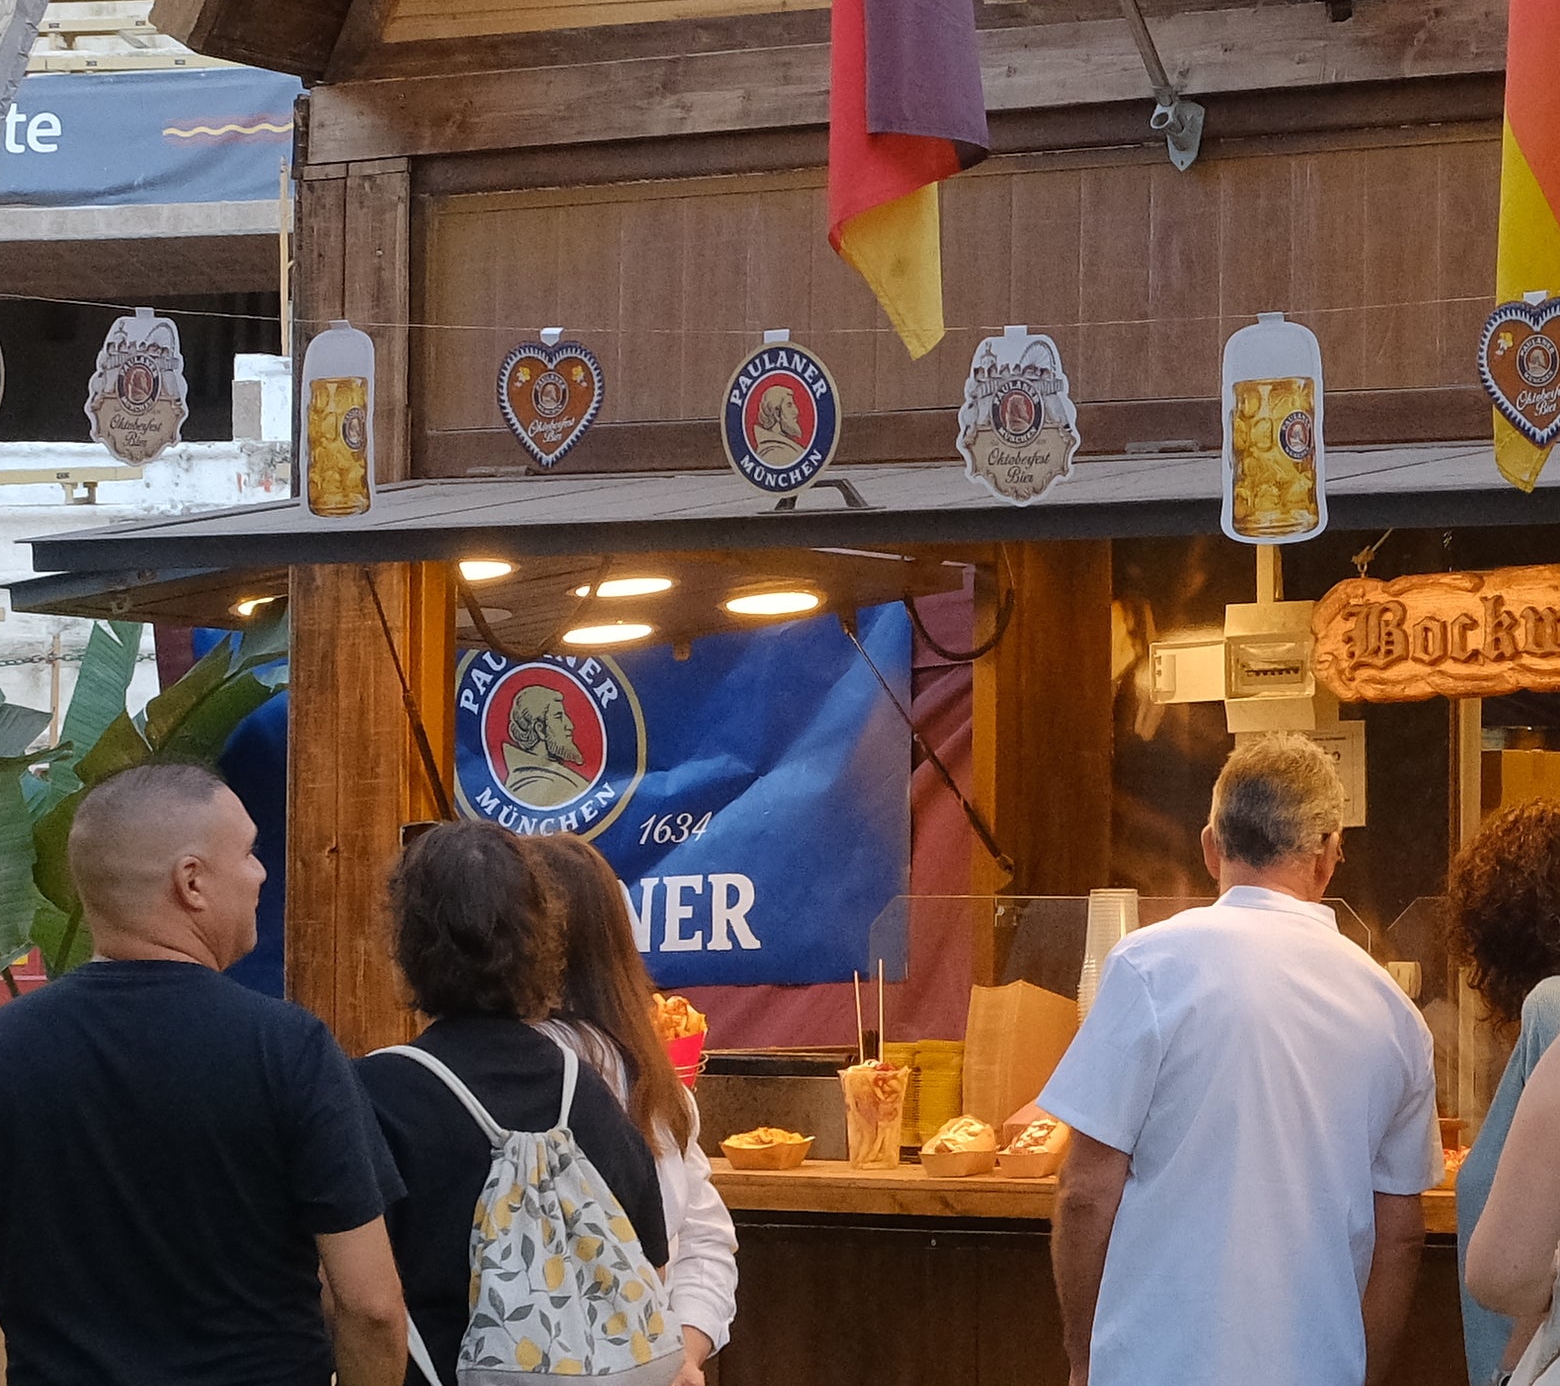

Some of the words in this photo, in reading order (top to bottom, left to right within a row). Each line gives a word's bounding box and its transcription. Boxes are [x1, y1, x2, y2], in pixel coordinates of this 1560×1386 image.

[729, 350, 828, 407] PAULANER
[109, 413, 163, 435] Oktoberfest
[740, 449, 823, 488] MÜNCHEN
[987, 447, 1051, 471] Oktoberfest
[1004, 465, 1035, 484] Bier
[475, 782, 617, 835] MÜNCHEN
[639, 811, 713, 845] 1634
